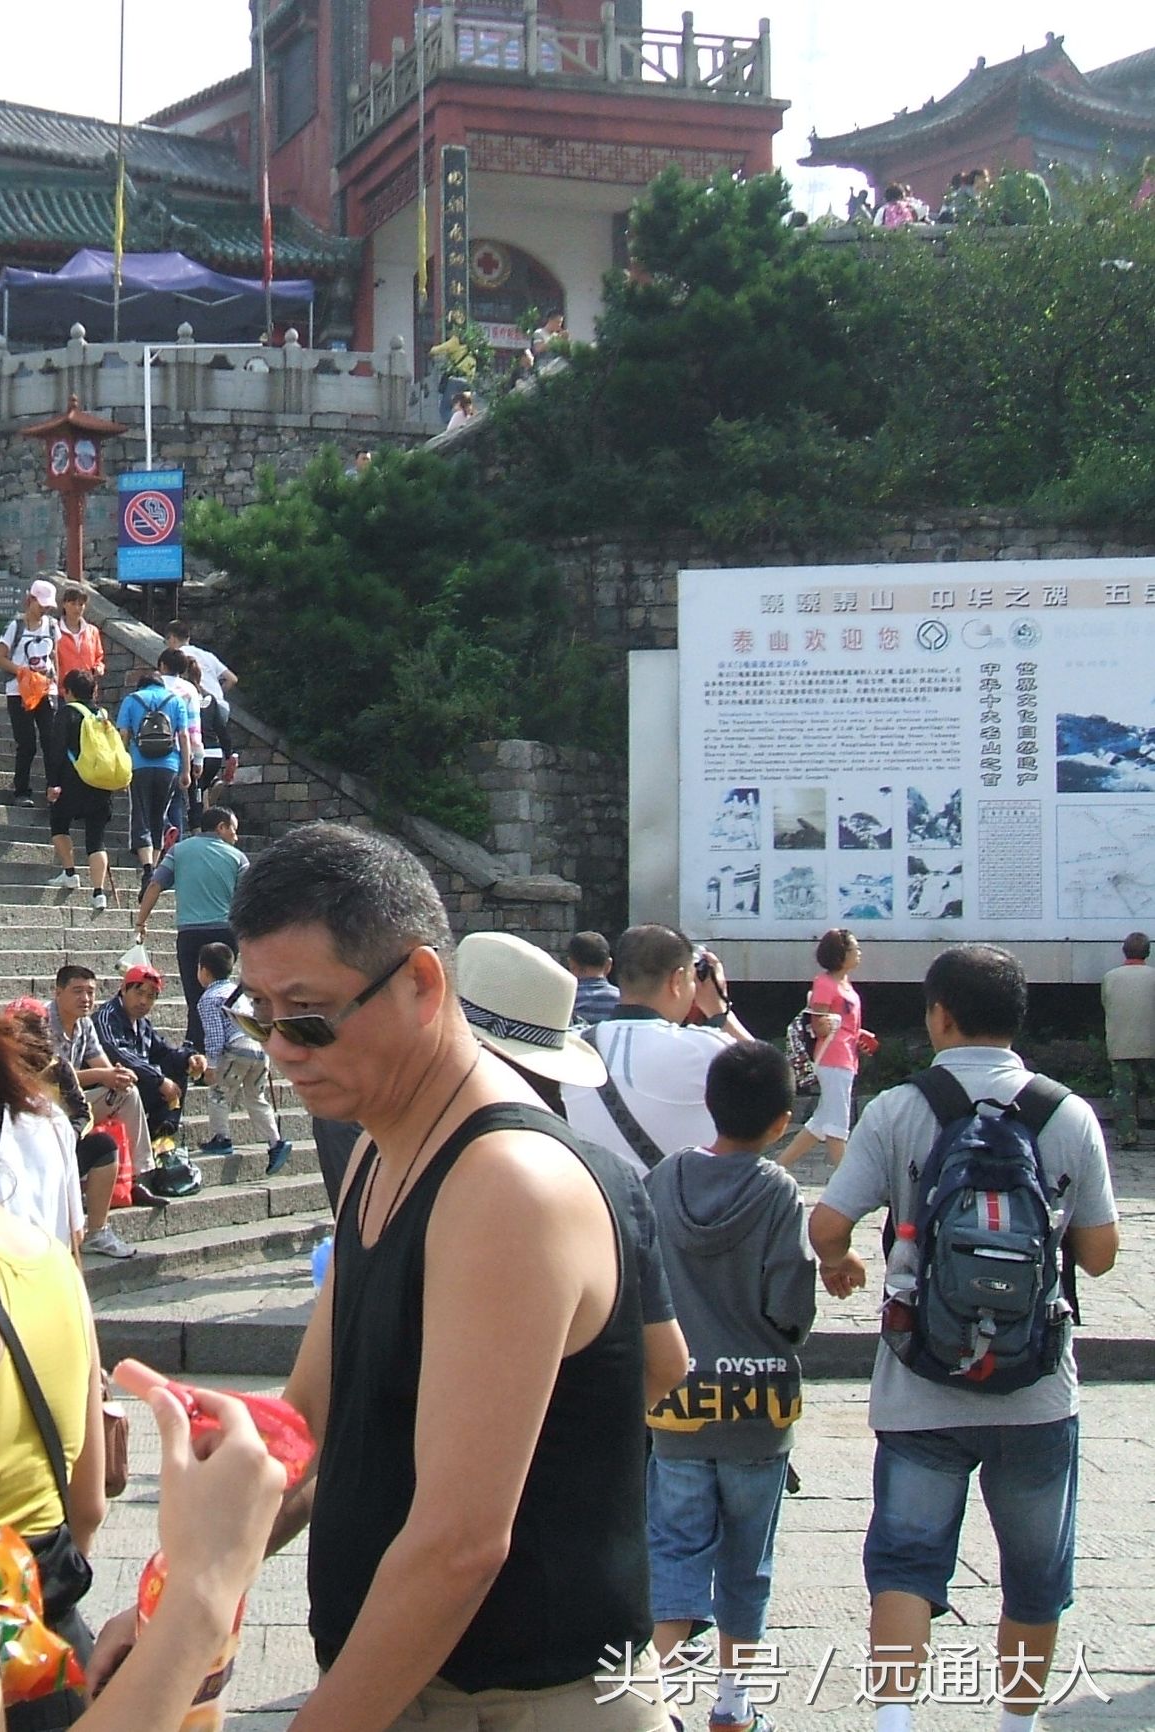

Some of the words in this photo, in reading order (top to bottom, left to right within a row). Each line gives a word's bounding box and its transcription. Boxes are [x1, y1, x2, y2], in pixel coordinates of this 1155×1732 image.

[929, 584, 1068, 610] 中华之魂
[732, 625, 901, 655] 泰山欢迎您
[978, 662, 1002, 787] 中华十大名山之首
[1015, 662, 1039, 787] 世界文化自然遗产
[715, 1356, 788, 1376] OYSTER
